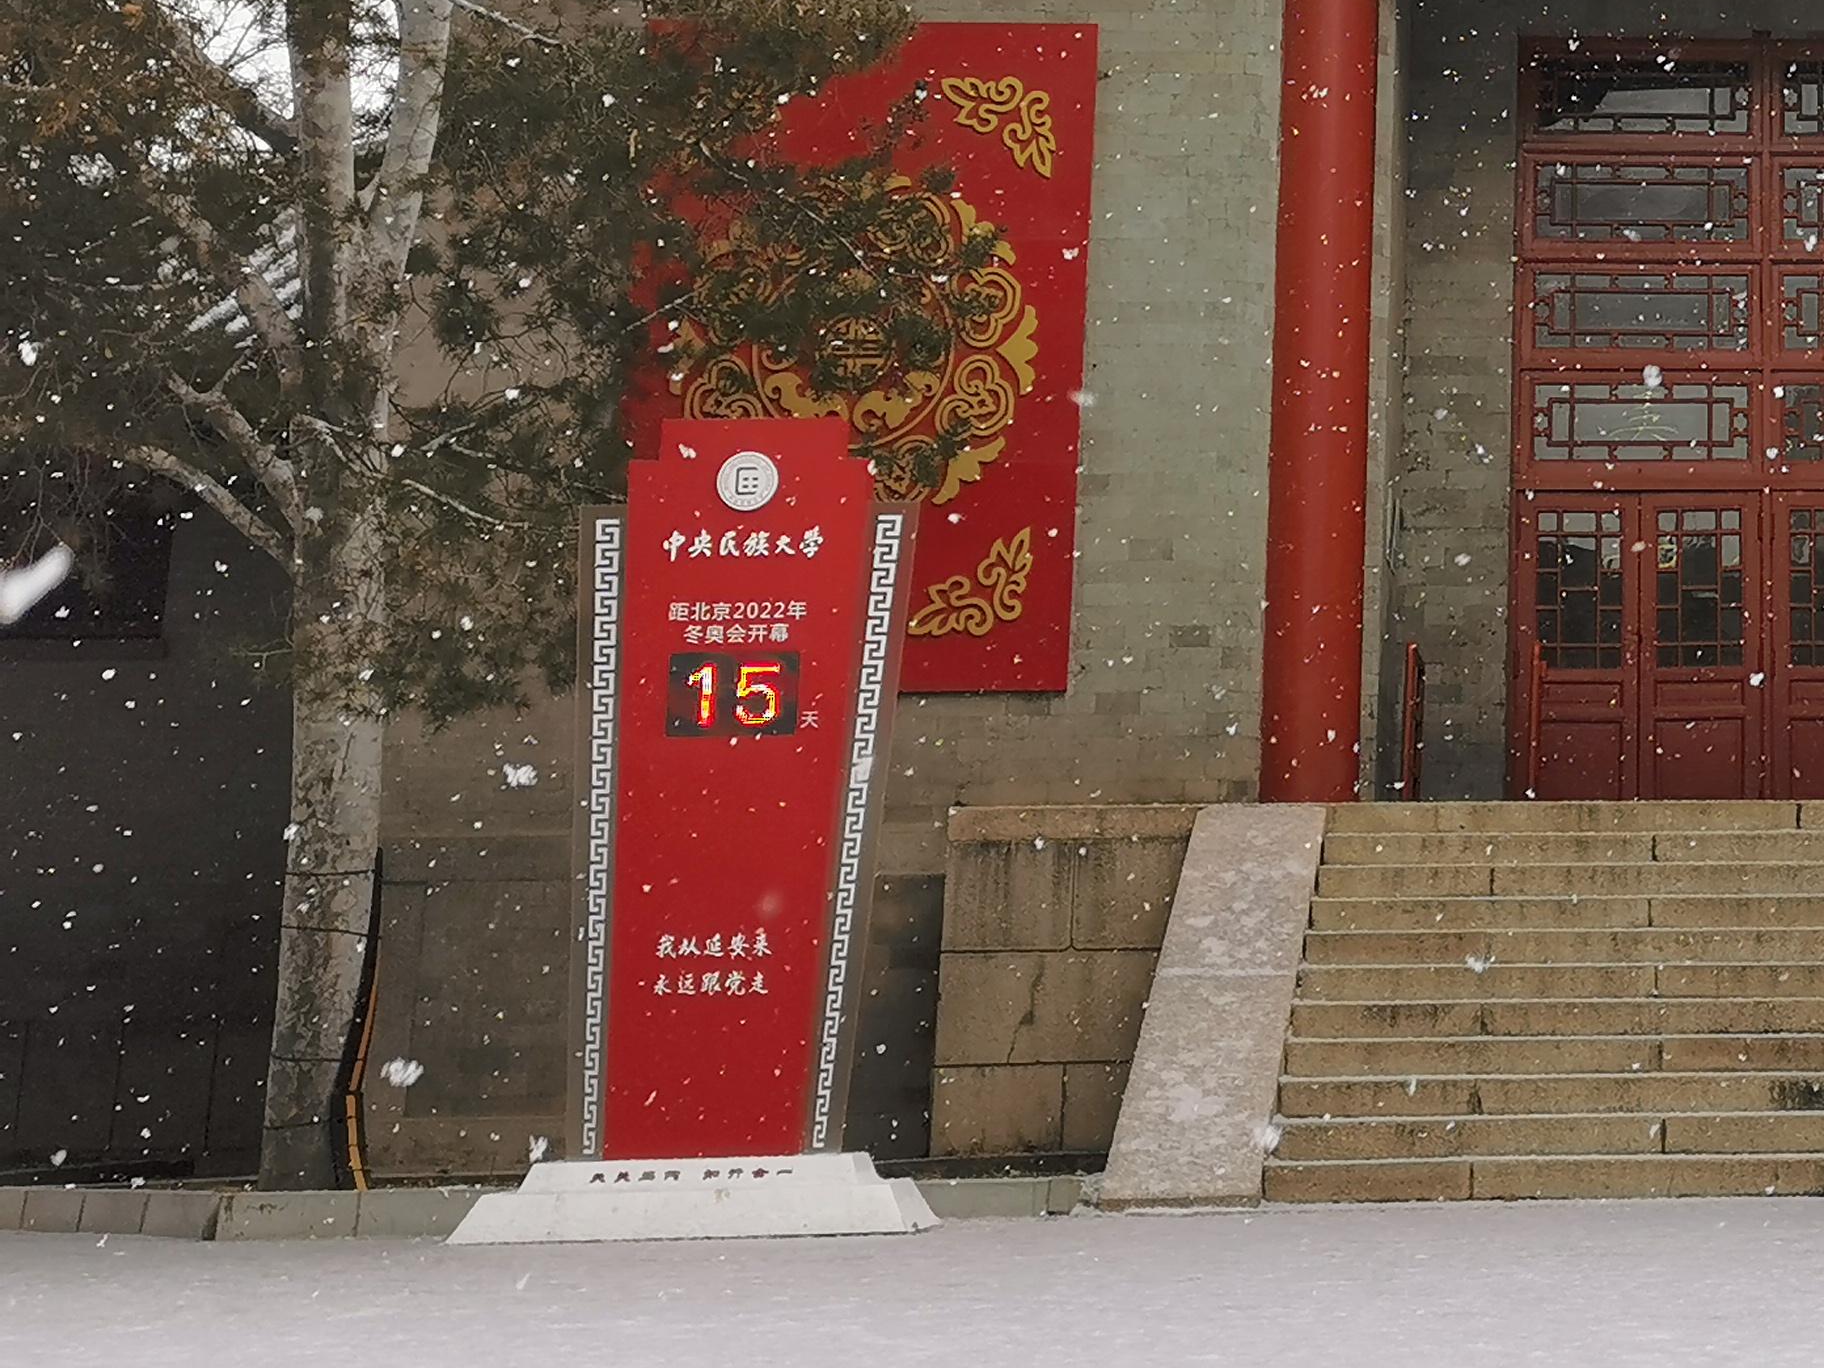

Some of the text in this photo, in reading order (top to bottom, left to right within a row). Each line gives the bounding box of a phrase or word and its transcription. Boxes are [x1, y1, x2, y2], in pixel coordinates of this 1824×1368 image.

[663, 526, 824, 562] 中央民族大学
[668, 601, 807, 621] 距北京2022年
[683, 624, 790, 644] 冬奥会开幕
[687, 662, 782, 728] 15
[801, 711, 819, 729] 天
[655, 932, 773, 958] 我从延安来
[653, 970, 769, 996] 永远跟党走
